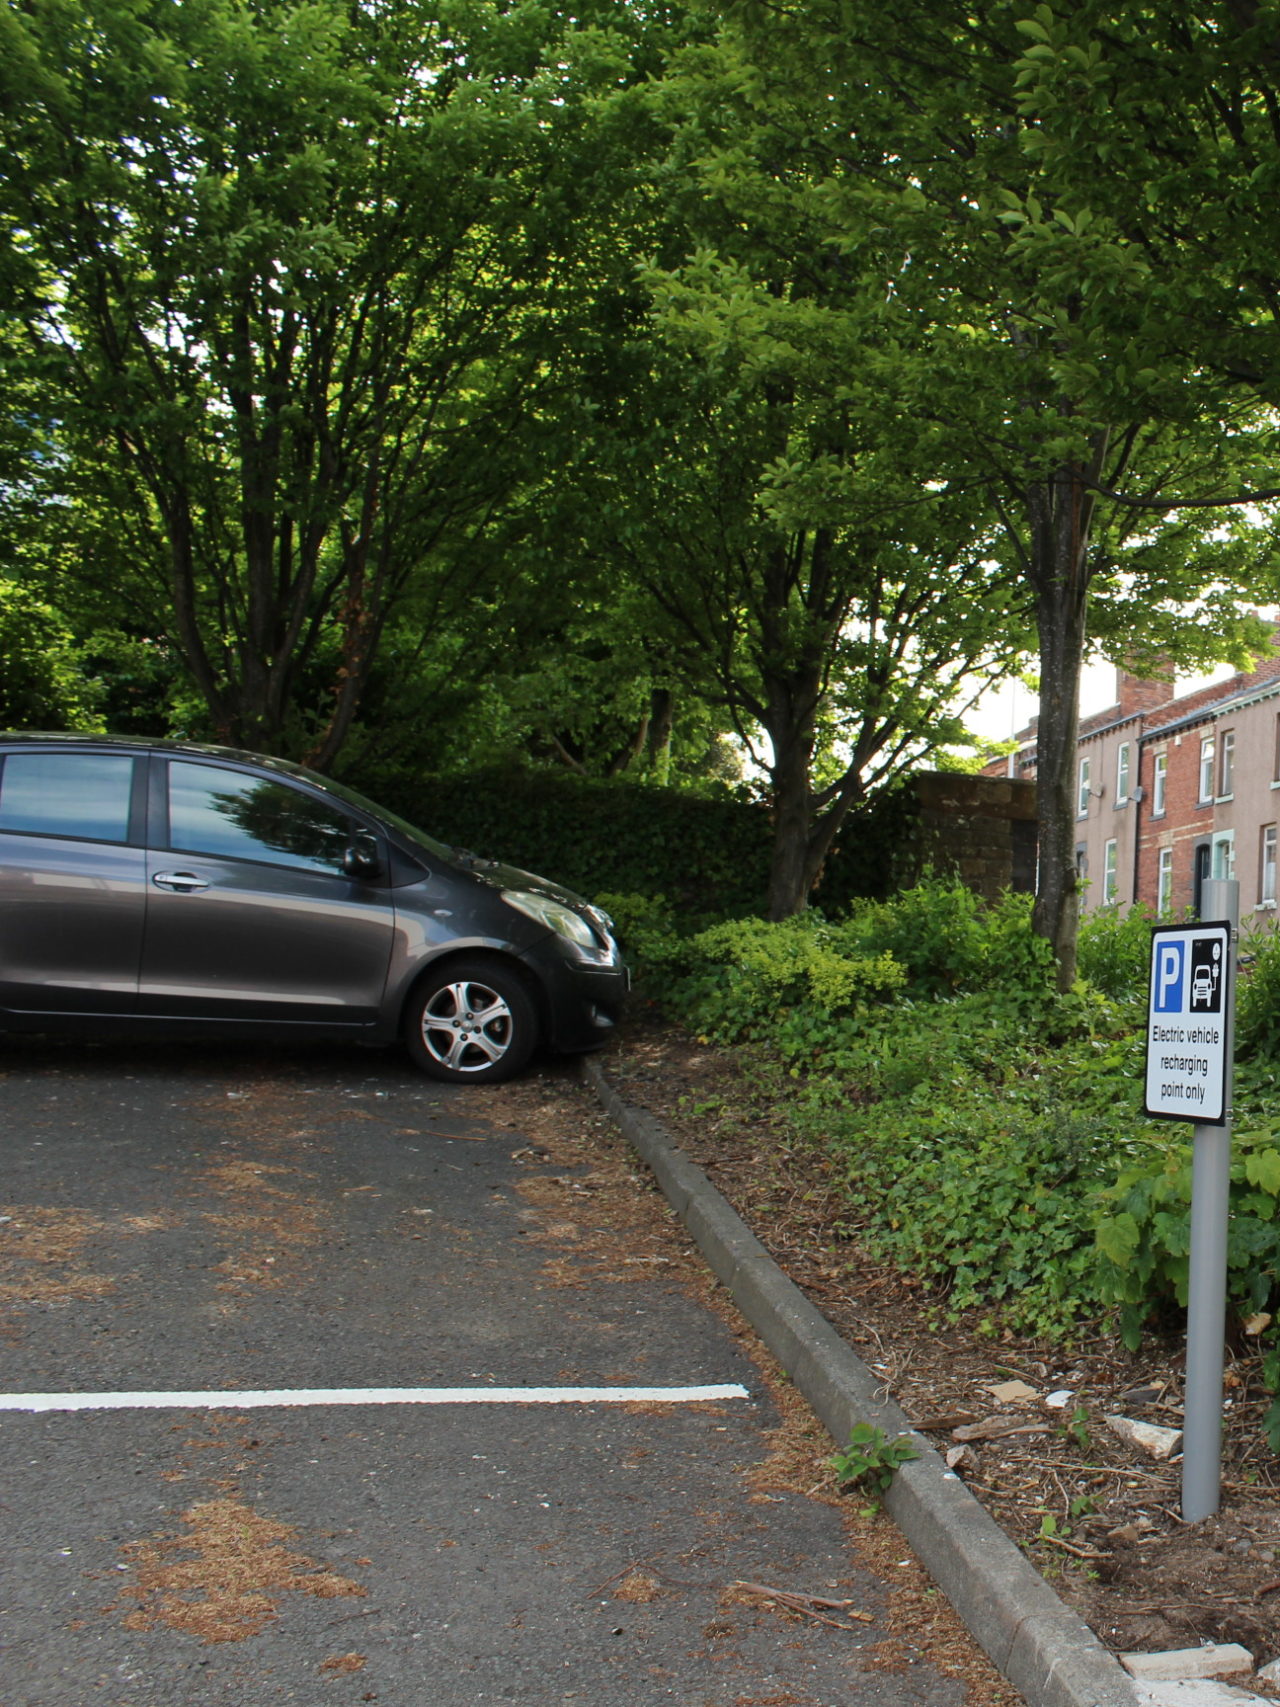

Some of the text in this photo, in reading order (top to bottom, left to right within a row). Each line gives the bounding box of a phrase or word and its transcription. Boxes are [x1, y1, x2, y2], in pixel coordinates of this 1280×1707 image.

[1159, 947, 1180, 1009] P
[1153, 1025, 1219, 1045] Electric vehicle
[1161, 1055, 1208, 1077] recharging
[1161, 1082, 1206, 1105] point only
